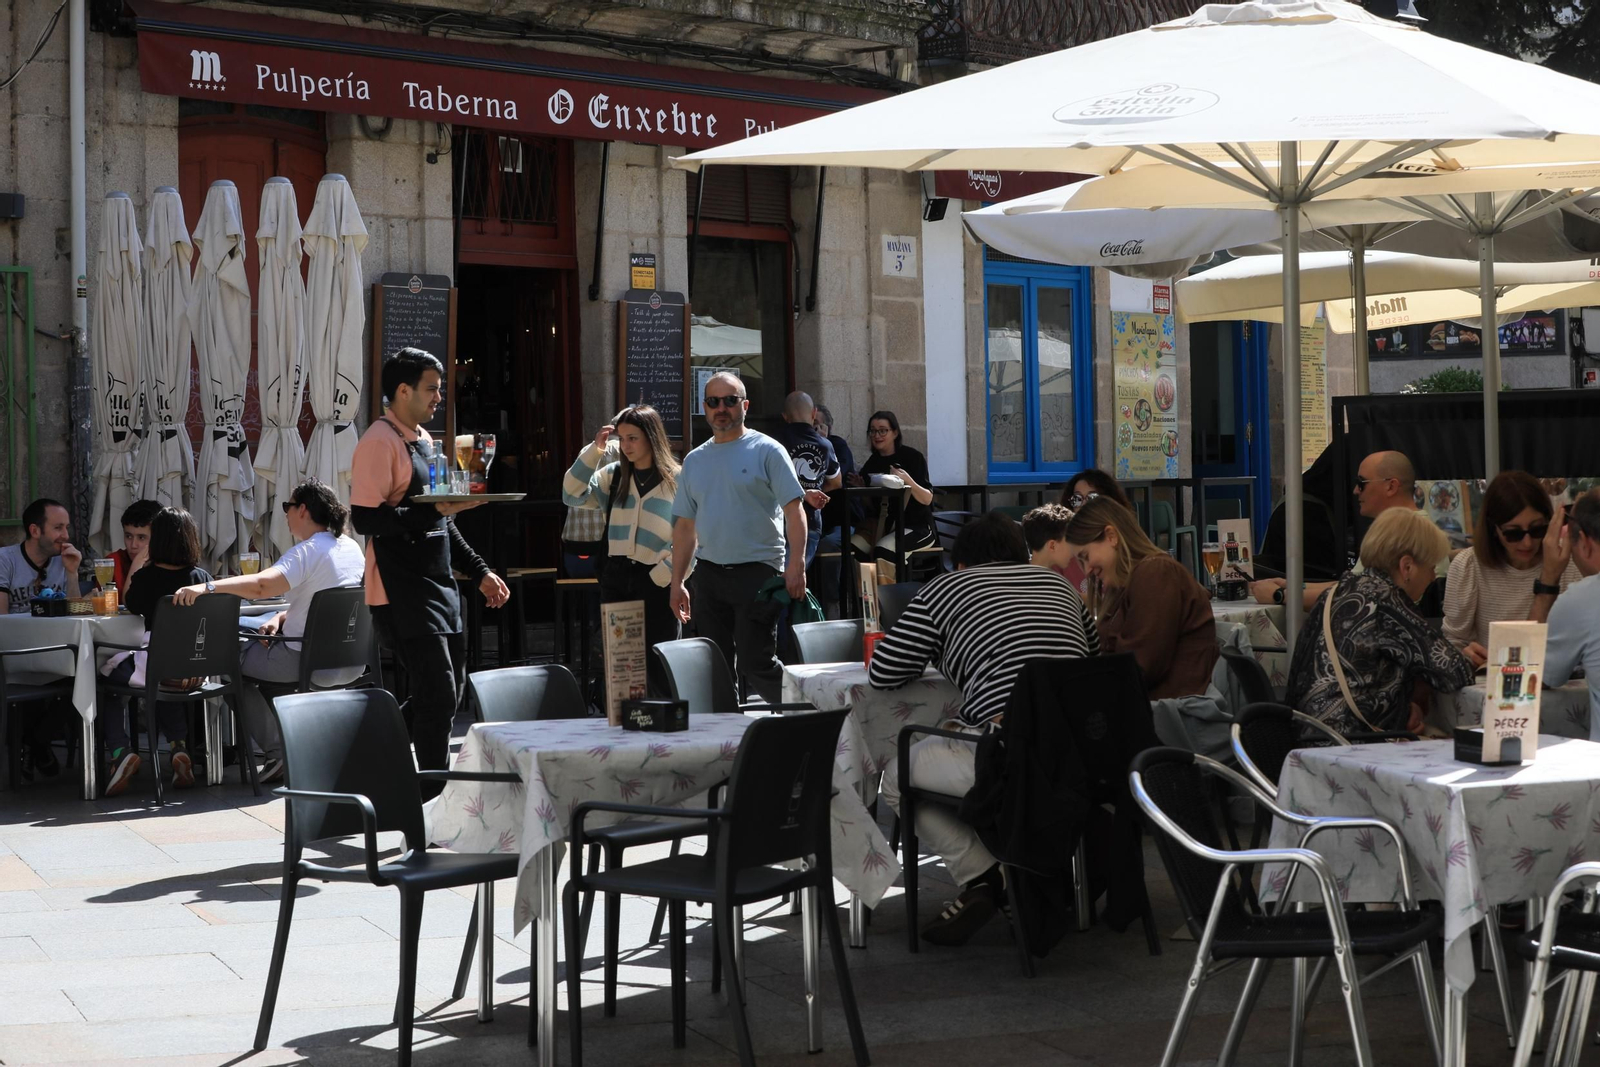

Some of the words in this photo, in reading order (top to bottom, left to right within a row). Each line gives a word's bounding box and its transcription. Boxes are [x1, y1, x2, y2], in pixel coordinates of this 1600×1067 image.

[255, 64, 371, 101] Pulpería
[402, 81, 519, 120] Taberna
[547, 88, 575, 125] O
[588, 93, 718, 138] Enxebre
[1078, 105, 1177, 117] Galicia
